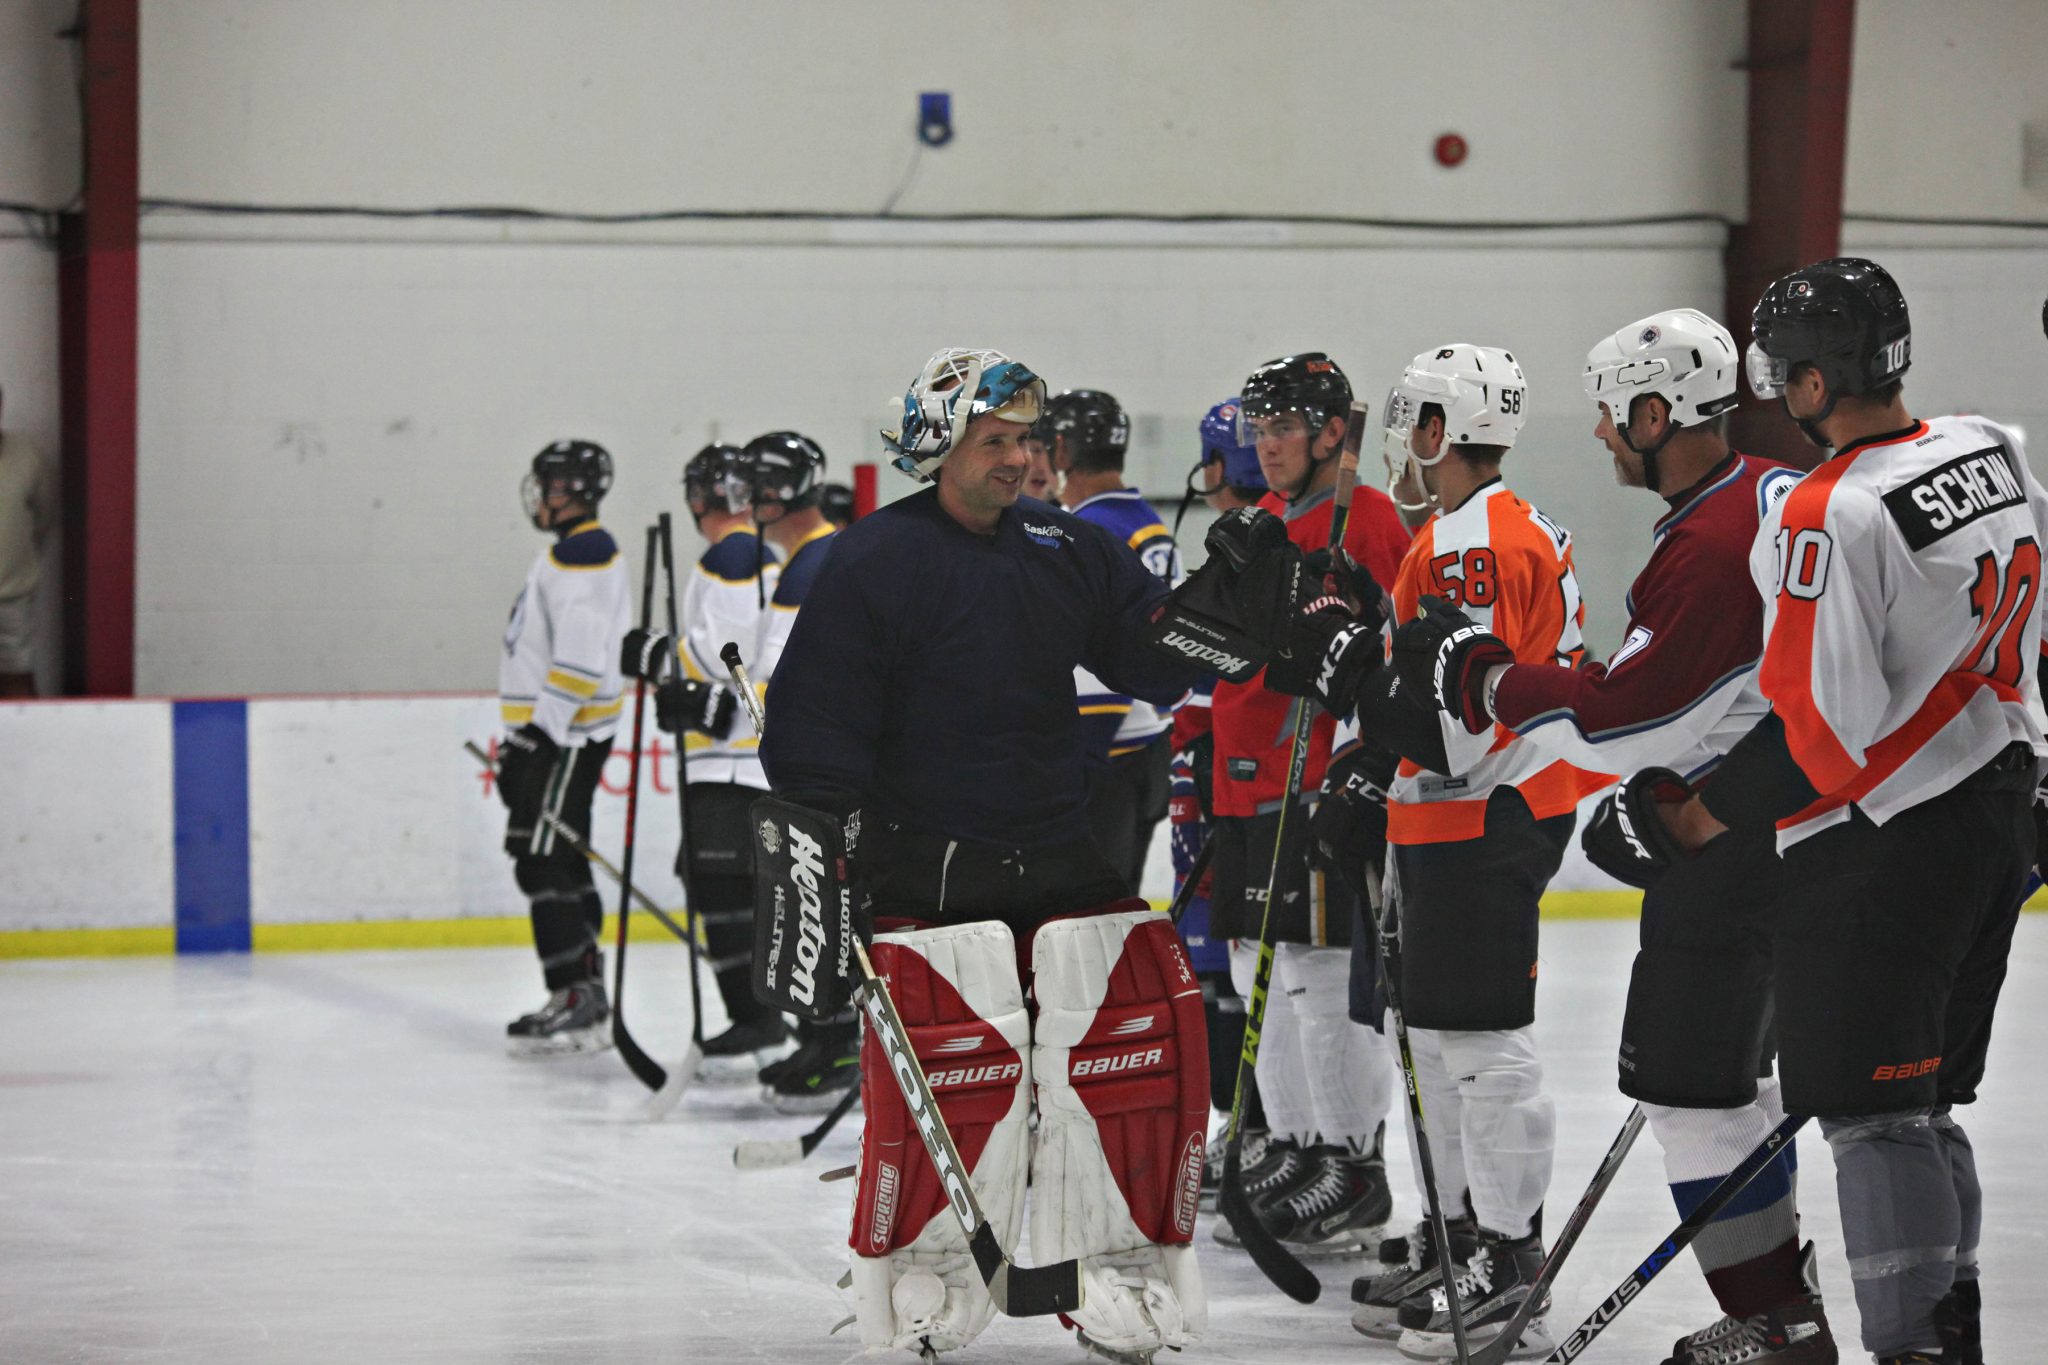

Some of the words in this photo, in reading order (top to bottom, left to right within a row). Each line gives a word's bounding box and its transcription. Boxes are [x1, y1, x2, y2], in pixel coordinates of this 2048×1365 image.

[1886, 341, 1906, 374] 10
[1500, 388, 1521, 415] 58
[1911, 452, 2023, 531] SCHENN
[1429, 547, 1497, 609] 58
[1774, 526, 1834, 601] 10
[1162, 631, 1250, 674] Heaton
[788, 823, 827, 1006] Heaton
[837, 887, 850, 978] Heaton
[927, 1062, 1021, 1088] BAUER
[1071, 1048, 1163, 1077] BAUER
[866, 989, 976, 1233] KOHO
